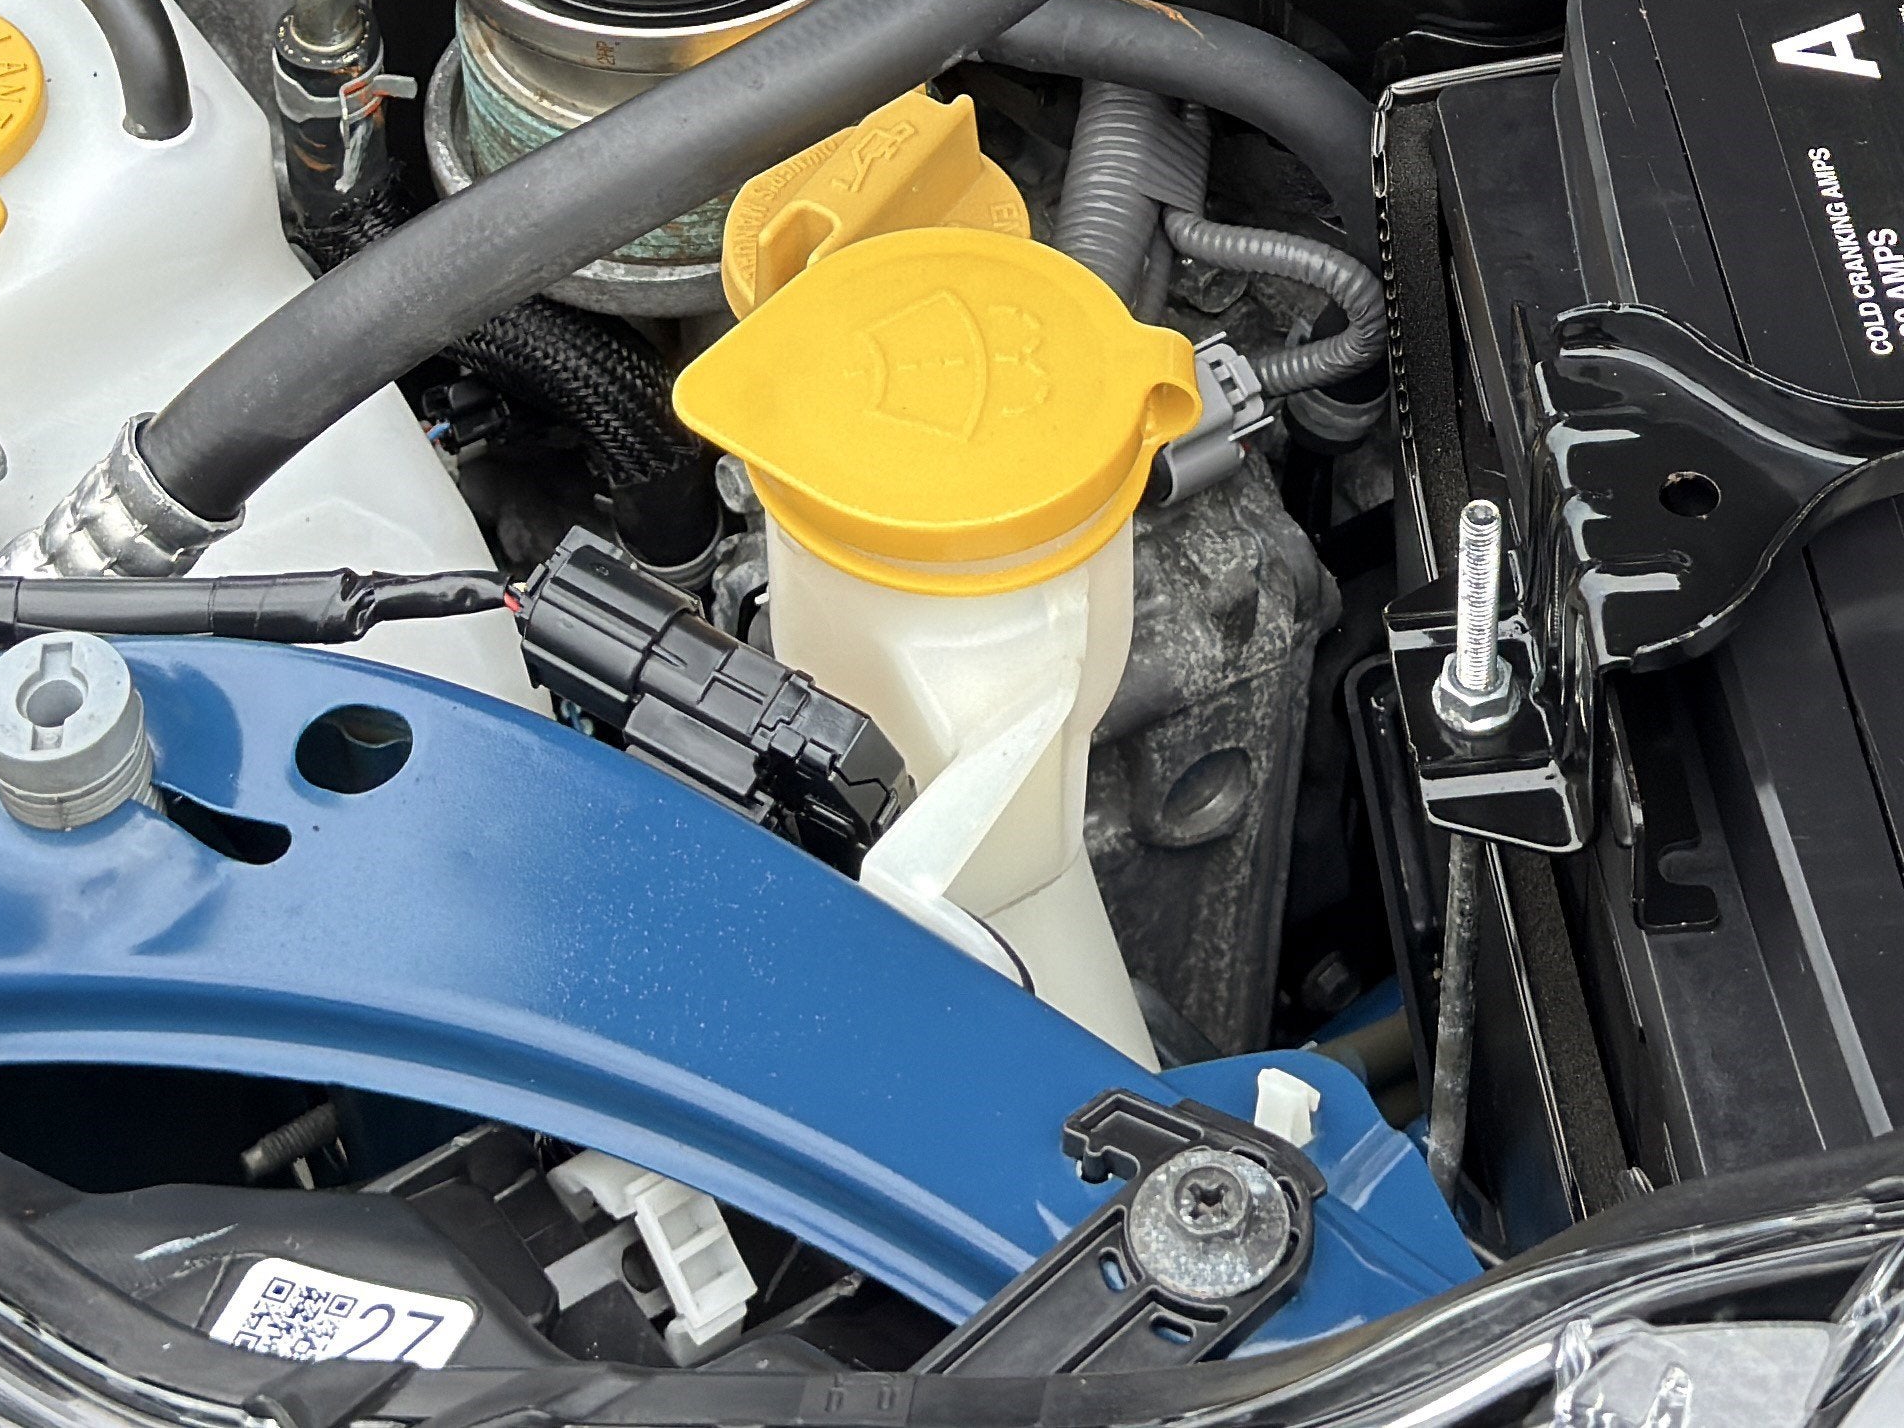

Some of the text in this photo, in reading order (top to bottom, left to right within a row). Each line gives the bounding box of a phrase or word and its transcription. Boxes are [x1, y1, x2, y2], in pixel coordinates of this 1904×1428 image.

[1771, 12, 1882, 79] A
[1807, 146, 1894, 356] COLD CRANKING AMPS
[336, 1303, 445, 1361] 27
